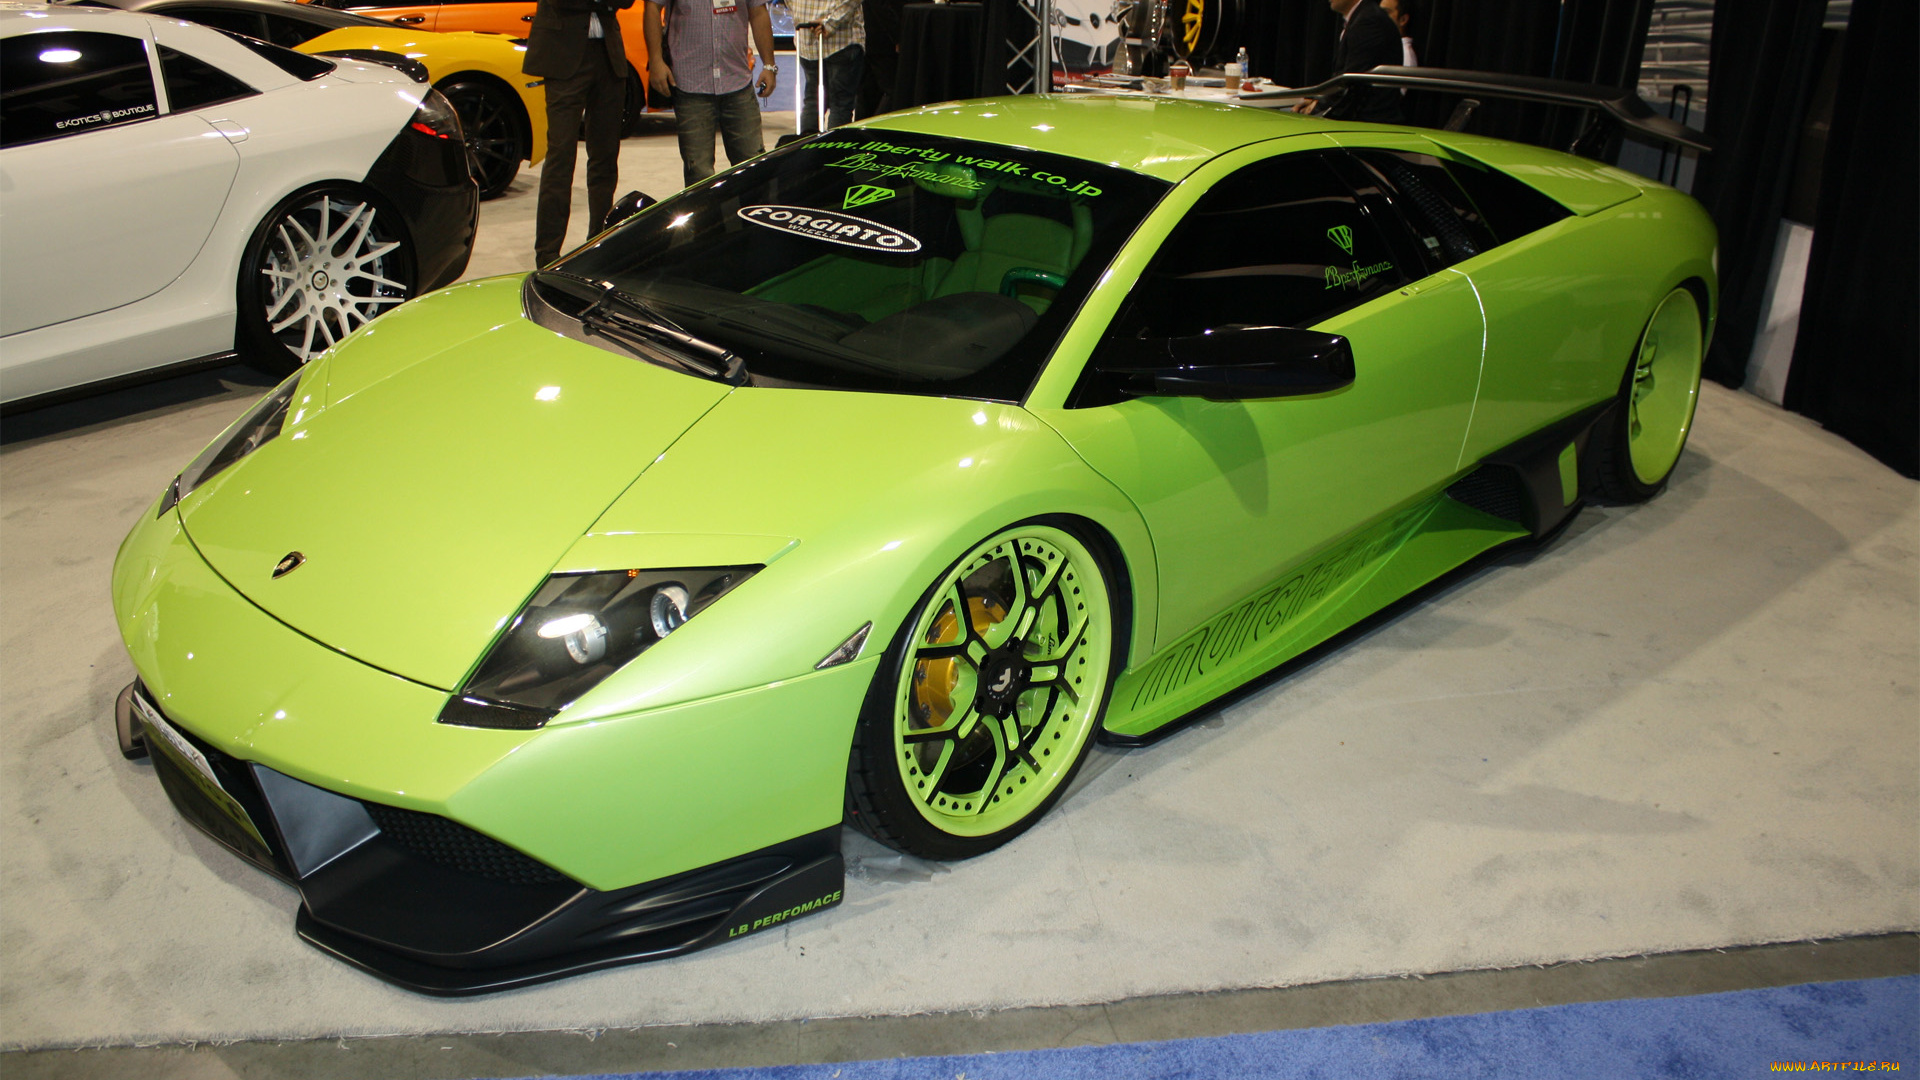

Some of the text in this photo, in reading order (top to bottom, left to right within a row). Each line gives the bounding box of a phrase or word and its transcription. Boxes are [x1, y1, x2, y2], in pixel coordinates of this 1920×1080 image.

[56, 104, 155, 129] EXOTICS BOUTIQUE
[748, 207, 903, 246] FORGIATO
[787, 223, 839, 240] WHEELS
[729, 890, 841, 938] LB PERFOMACE
